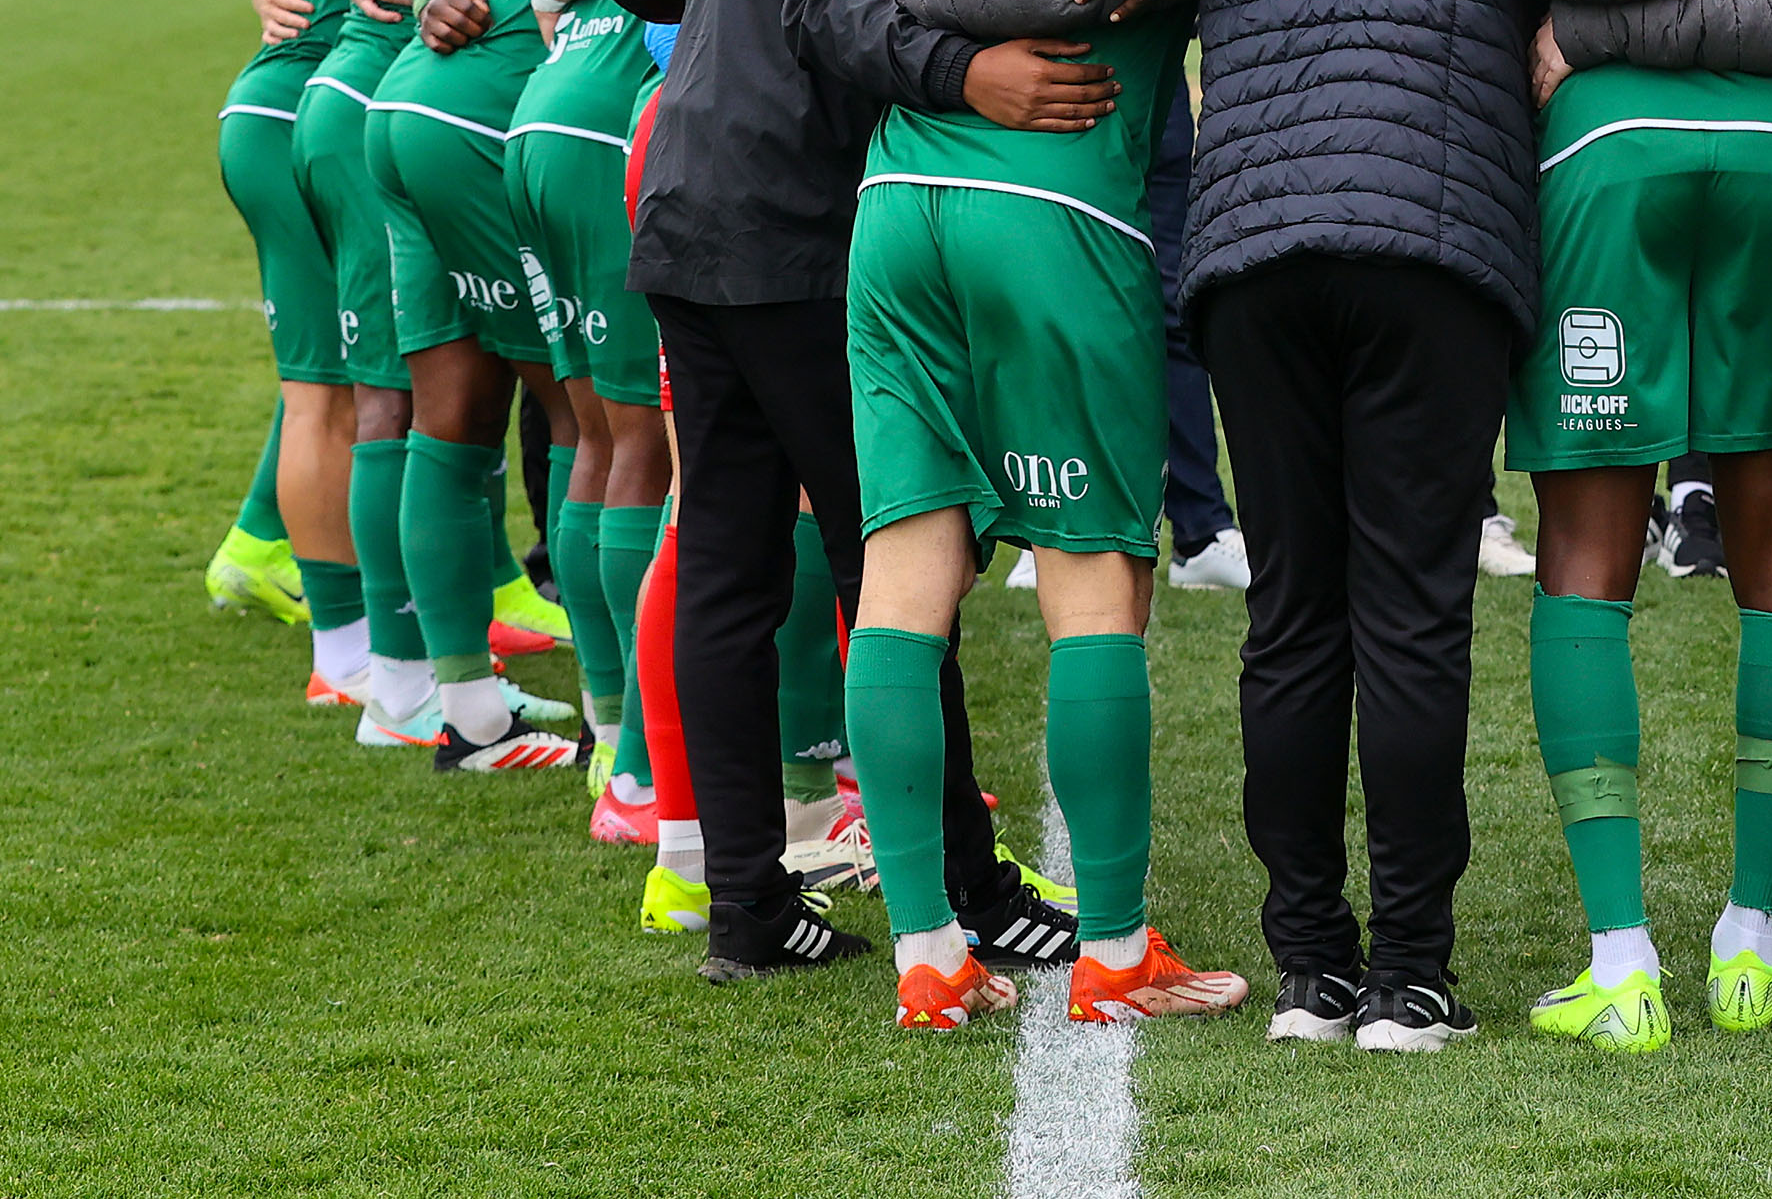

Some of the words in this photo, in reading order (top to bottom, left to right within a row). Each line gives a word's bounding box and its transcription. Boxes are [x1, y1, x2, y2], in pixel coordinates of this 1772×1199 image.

[1560, 394, 1629, 415] KICK-OFF
[1003, 451, 1089, 500] one
[1029, 497, 1061, 509] LIGHT
